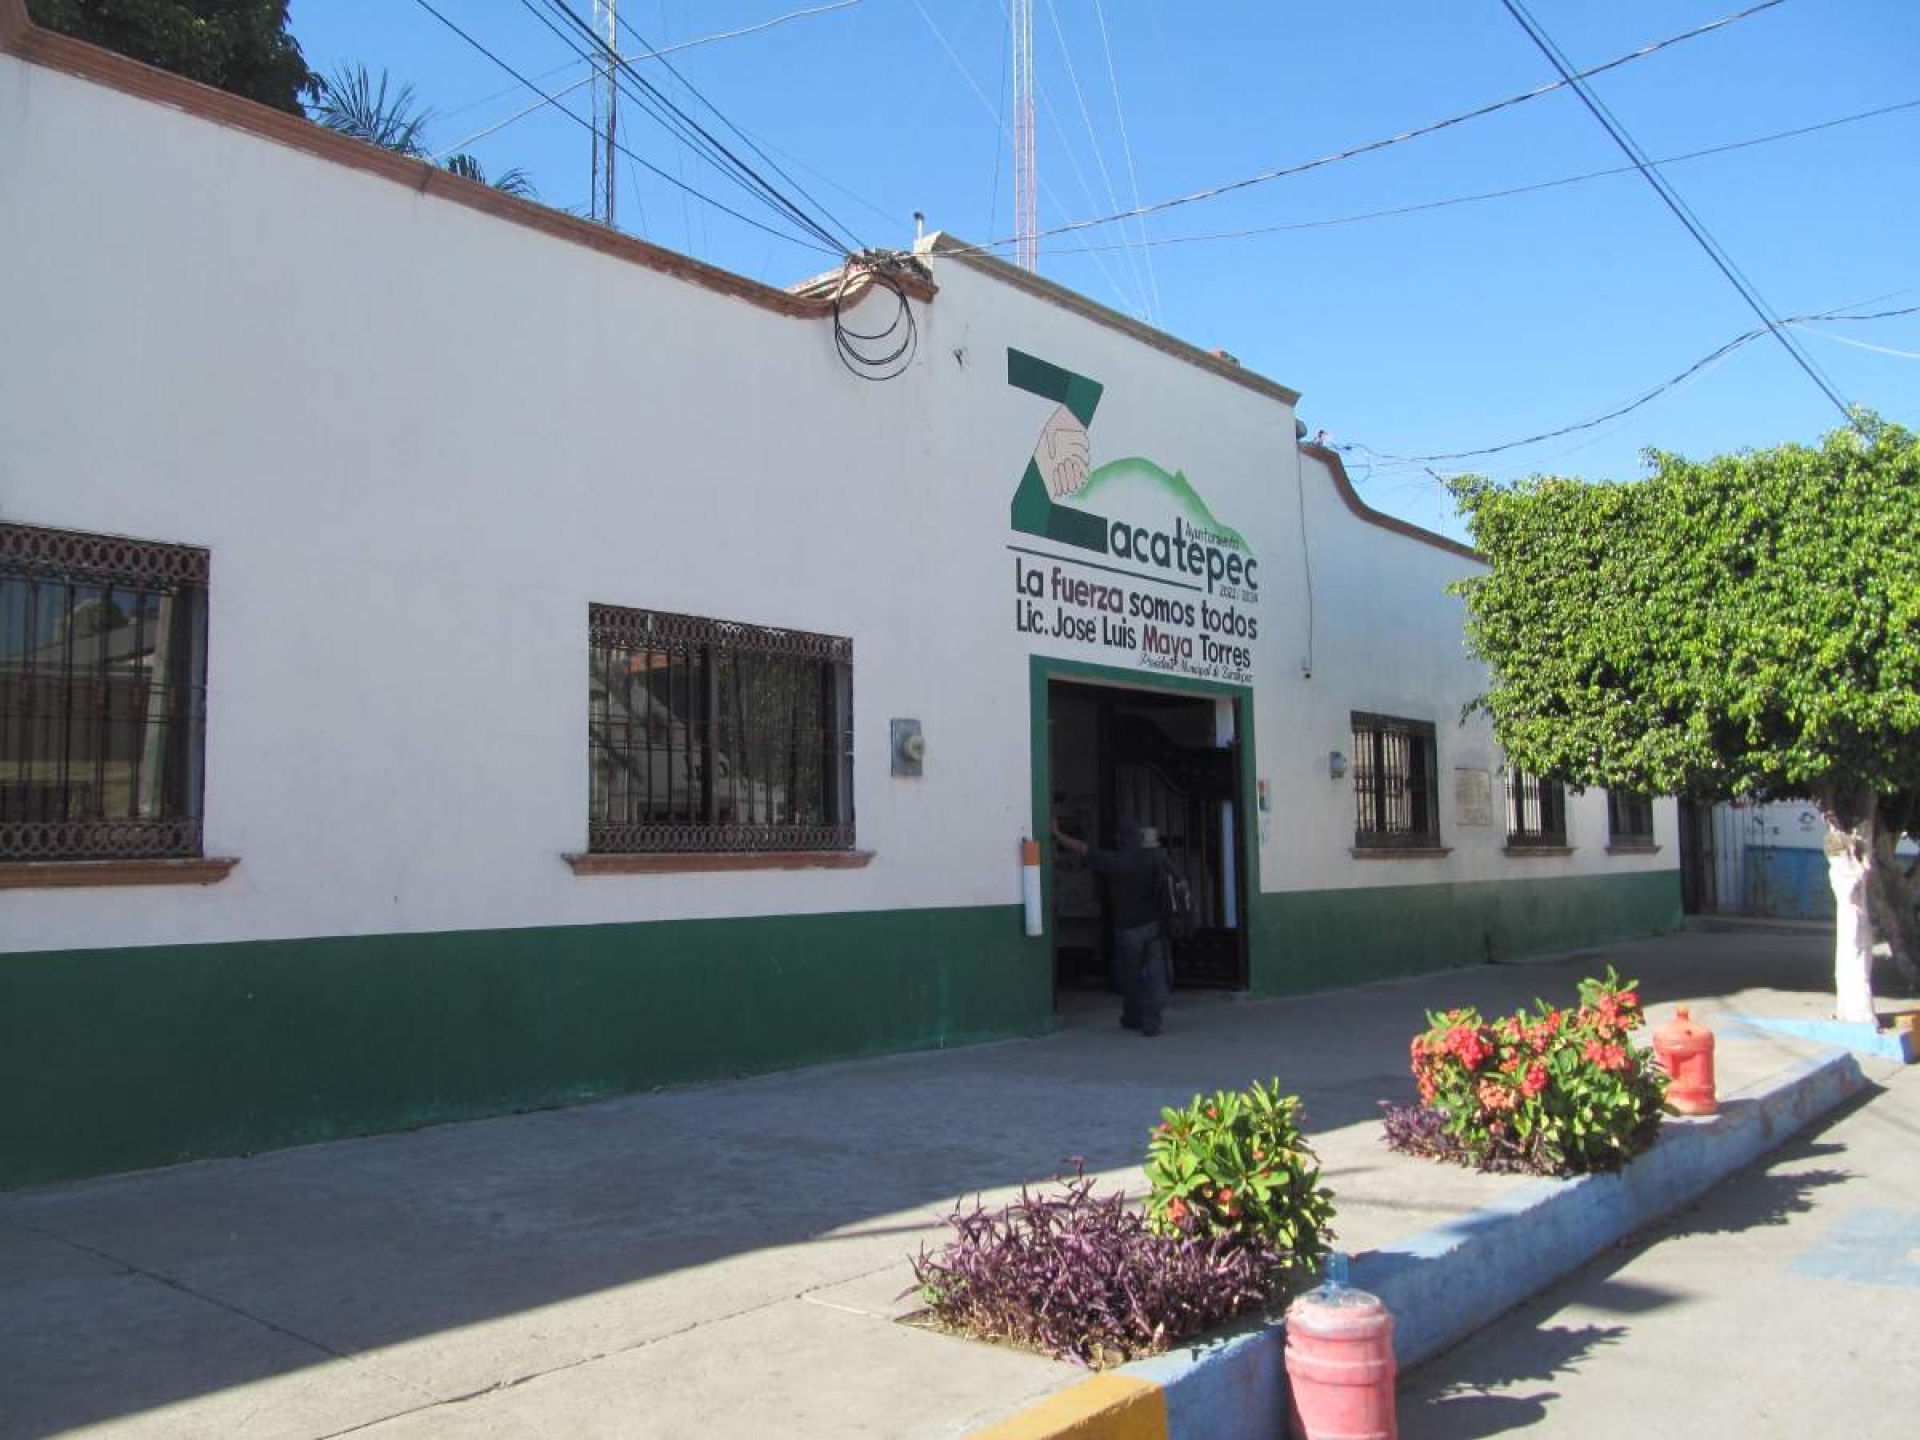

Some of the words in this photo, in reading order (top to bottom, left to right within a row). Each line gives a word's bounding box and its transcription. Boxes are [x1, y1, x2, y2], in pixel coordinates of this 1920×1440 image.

[1016, 557, 1044, 598] La
[1051, 566, 1124, 614] fuerza
[1129, 591, 1195, 627] somos
[1201, 599, 1257, 640] todos
[1016, 598, 1049, 635] Lic.
[1103, 615, 1137, 650] Luis
[1142, 623, 1193, 666] Maya
[1198, 634, 1251, 668] Torres
